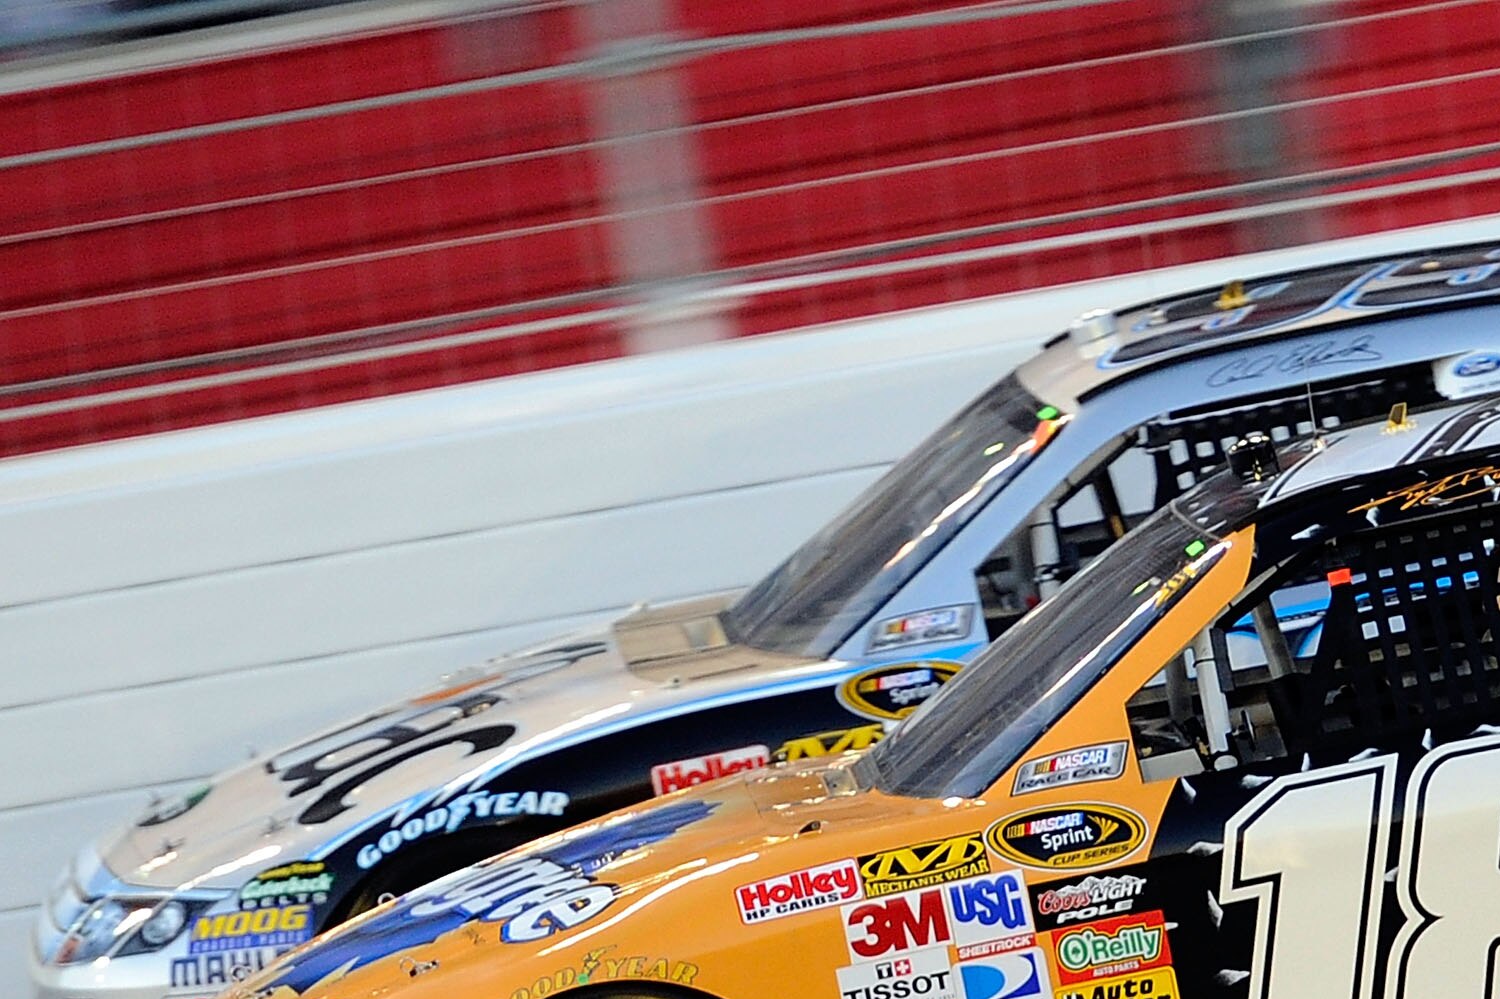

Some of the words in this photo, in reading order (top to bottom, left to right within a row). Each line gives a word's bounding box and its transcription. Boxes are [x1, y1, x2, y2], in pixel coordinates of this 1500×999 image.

[1056, 748, 1109, 771] NASCAR
[1020, 774, 1069, 789] RACE
[1072, 766, 1112, 779] CAR
[1031, 812, 1085, 835] NASCAR
[1041, 825, 1095, 852] Sprint
[1053, 852, 1082, 866] CUP
[1084, 843, 1130, 859] SERIES
[741, 867, 860, 911] Holley
[864, 873, 944, 898] MECHANIX
[949, 858, 990, 882] WEAR
[746, 907, 771, 921] HP
[776, 891, 840, 915] CARBS
[950, 875, 1027, 930] USG
[1037, 889, 1091, 915] Coors
[1091, 877, 1147, 904] LIGHT
[1056, 899, 1134, 925] POLE
[192, 904, 312, 940] MOOG
[848, 889, 950, 957] 3M
[958, 934, 1034, 960] SHEETROCK
[1063, 929, 1158, 967] O'Reilly
[171, 947, 292, 988] MAHL
